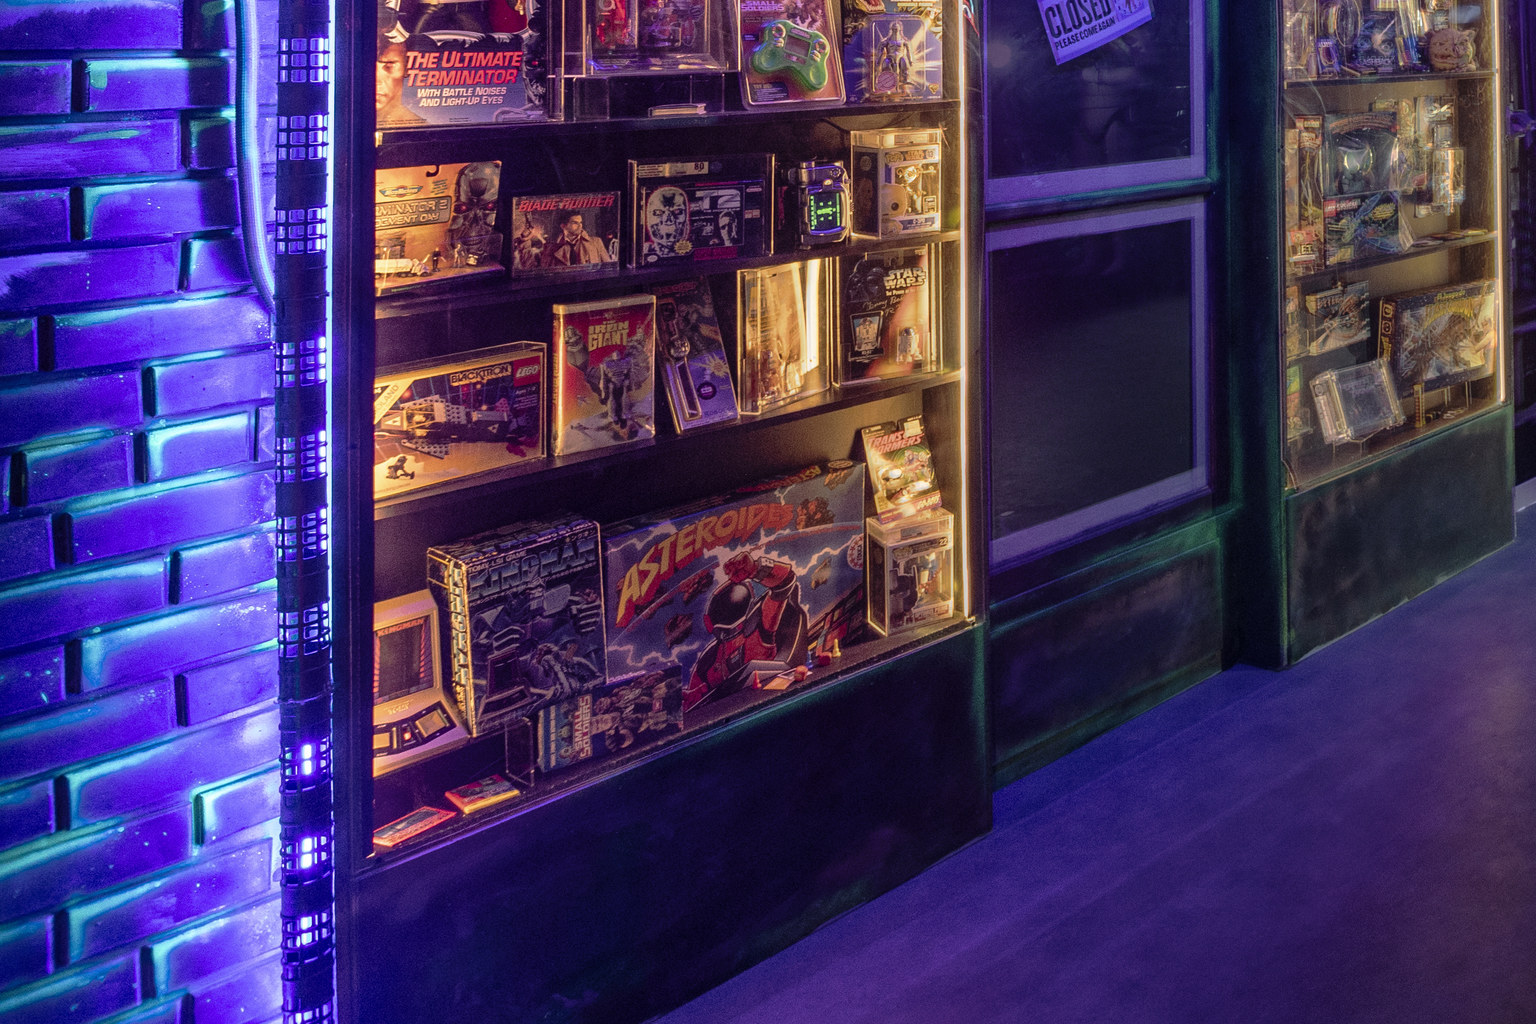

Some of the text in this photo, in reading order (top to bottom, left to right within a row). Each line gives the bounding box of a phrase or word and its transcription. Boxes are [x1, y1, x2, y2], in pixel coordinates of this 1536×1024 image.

[1055, 15, 1117, 51] PLEASE COME AGAIN
[406, 50, 524, 69] THE ULTIMATE
[407, 69, 518, 87] TERMINATOR
[417, 86, 507, 98] WITH BATTLE NOISES
[418, 95, 504, 107] AND LIGHT-UP EYES
[519, 195, 616, 212] BLADE RUNNER
[887, 266, 926, 281] STAR
[884, 275, 926, 290] WARS
[588, 320, 630, 335] IRON
[588, 329, 630, 353] GIANT
[451, 363, 512, 385] BLACKTRON
[515, 365, 540, 378] LEGO
[615, 503, 795, 628] ASTEROIDES
